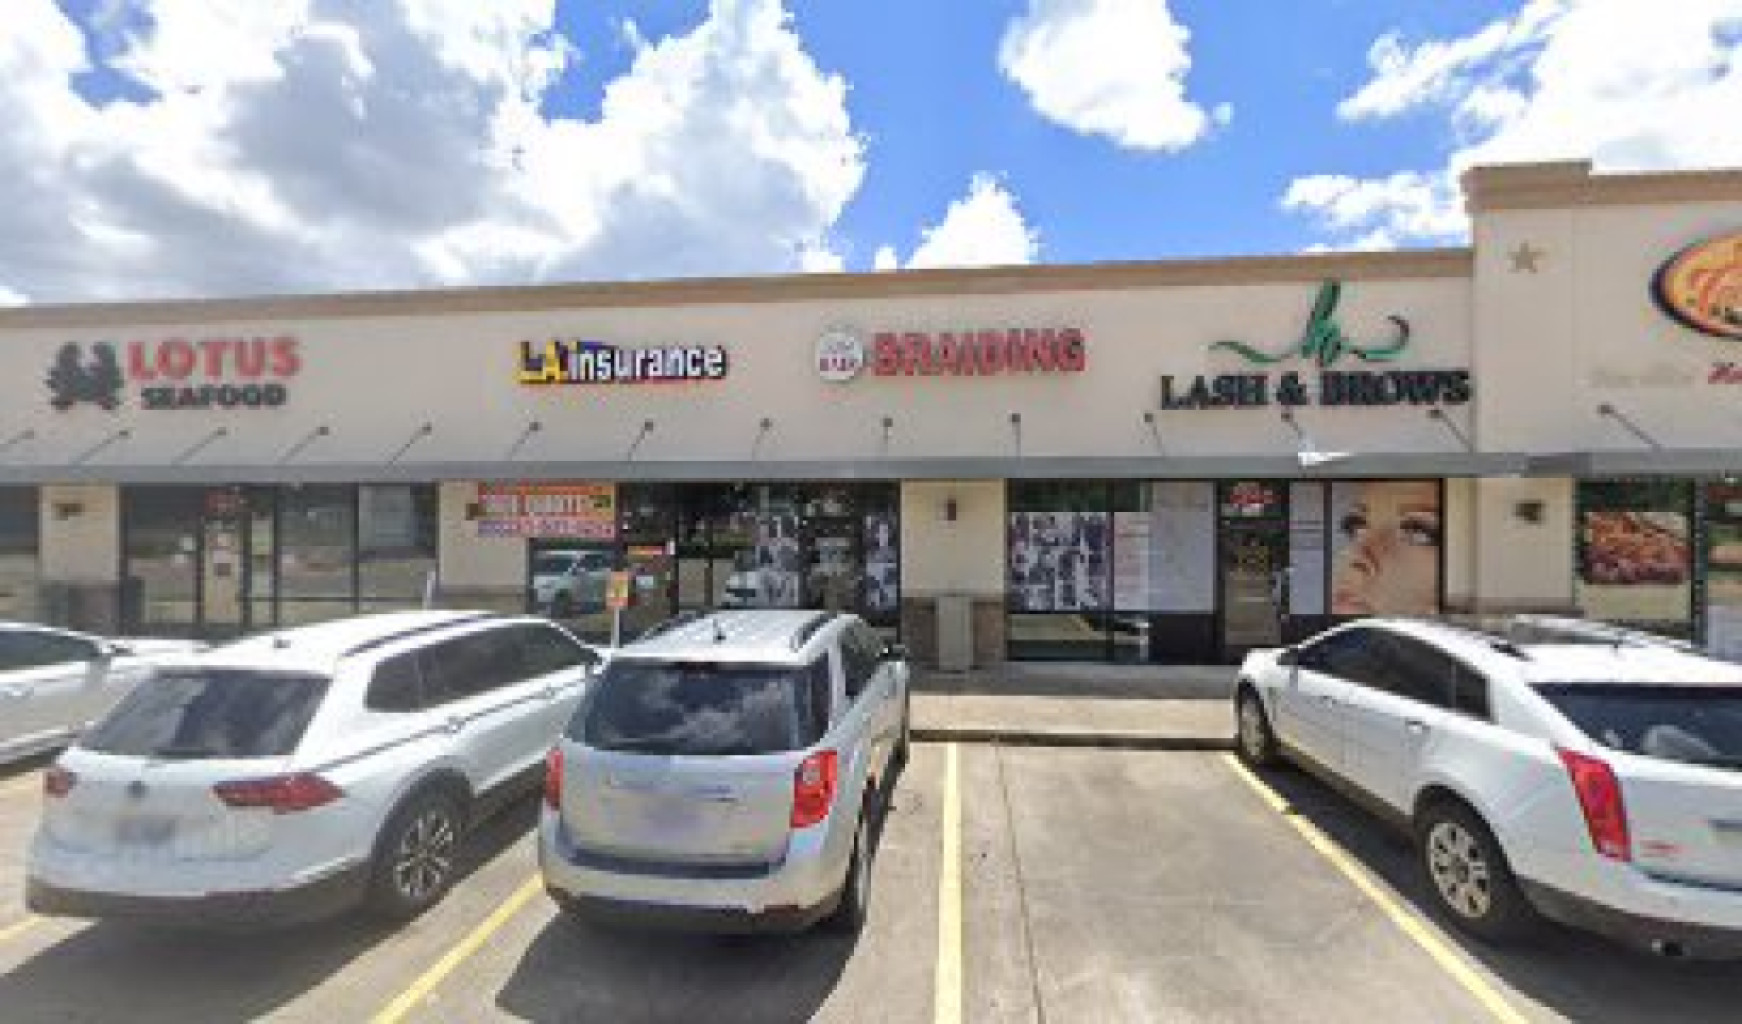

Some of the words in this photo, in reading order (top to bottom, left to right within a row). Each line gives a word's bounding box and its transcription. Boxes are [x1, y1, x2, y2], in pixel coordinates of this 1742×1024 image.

[127, 337, 302, 380] LOTUS
[873, 330, 1086, 376] BRAIDING
[141, 384, 287, 410] SEAFOOD
[1160, 375, 1268, 410] LASH
[1277, 371, 1307, 406] &
[1320, 370, 1470, 406] BROWS
